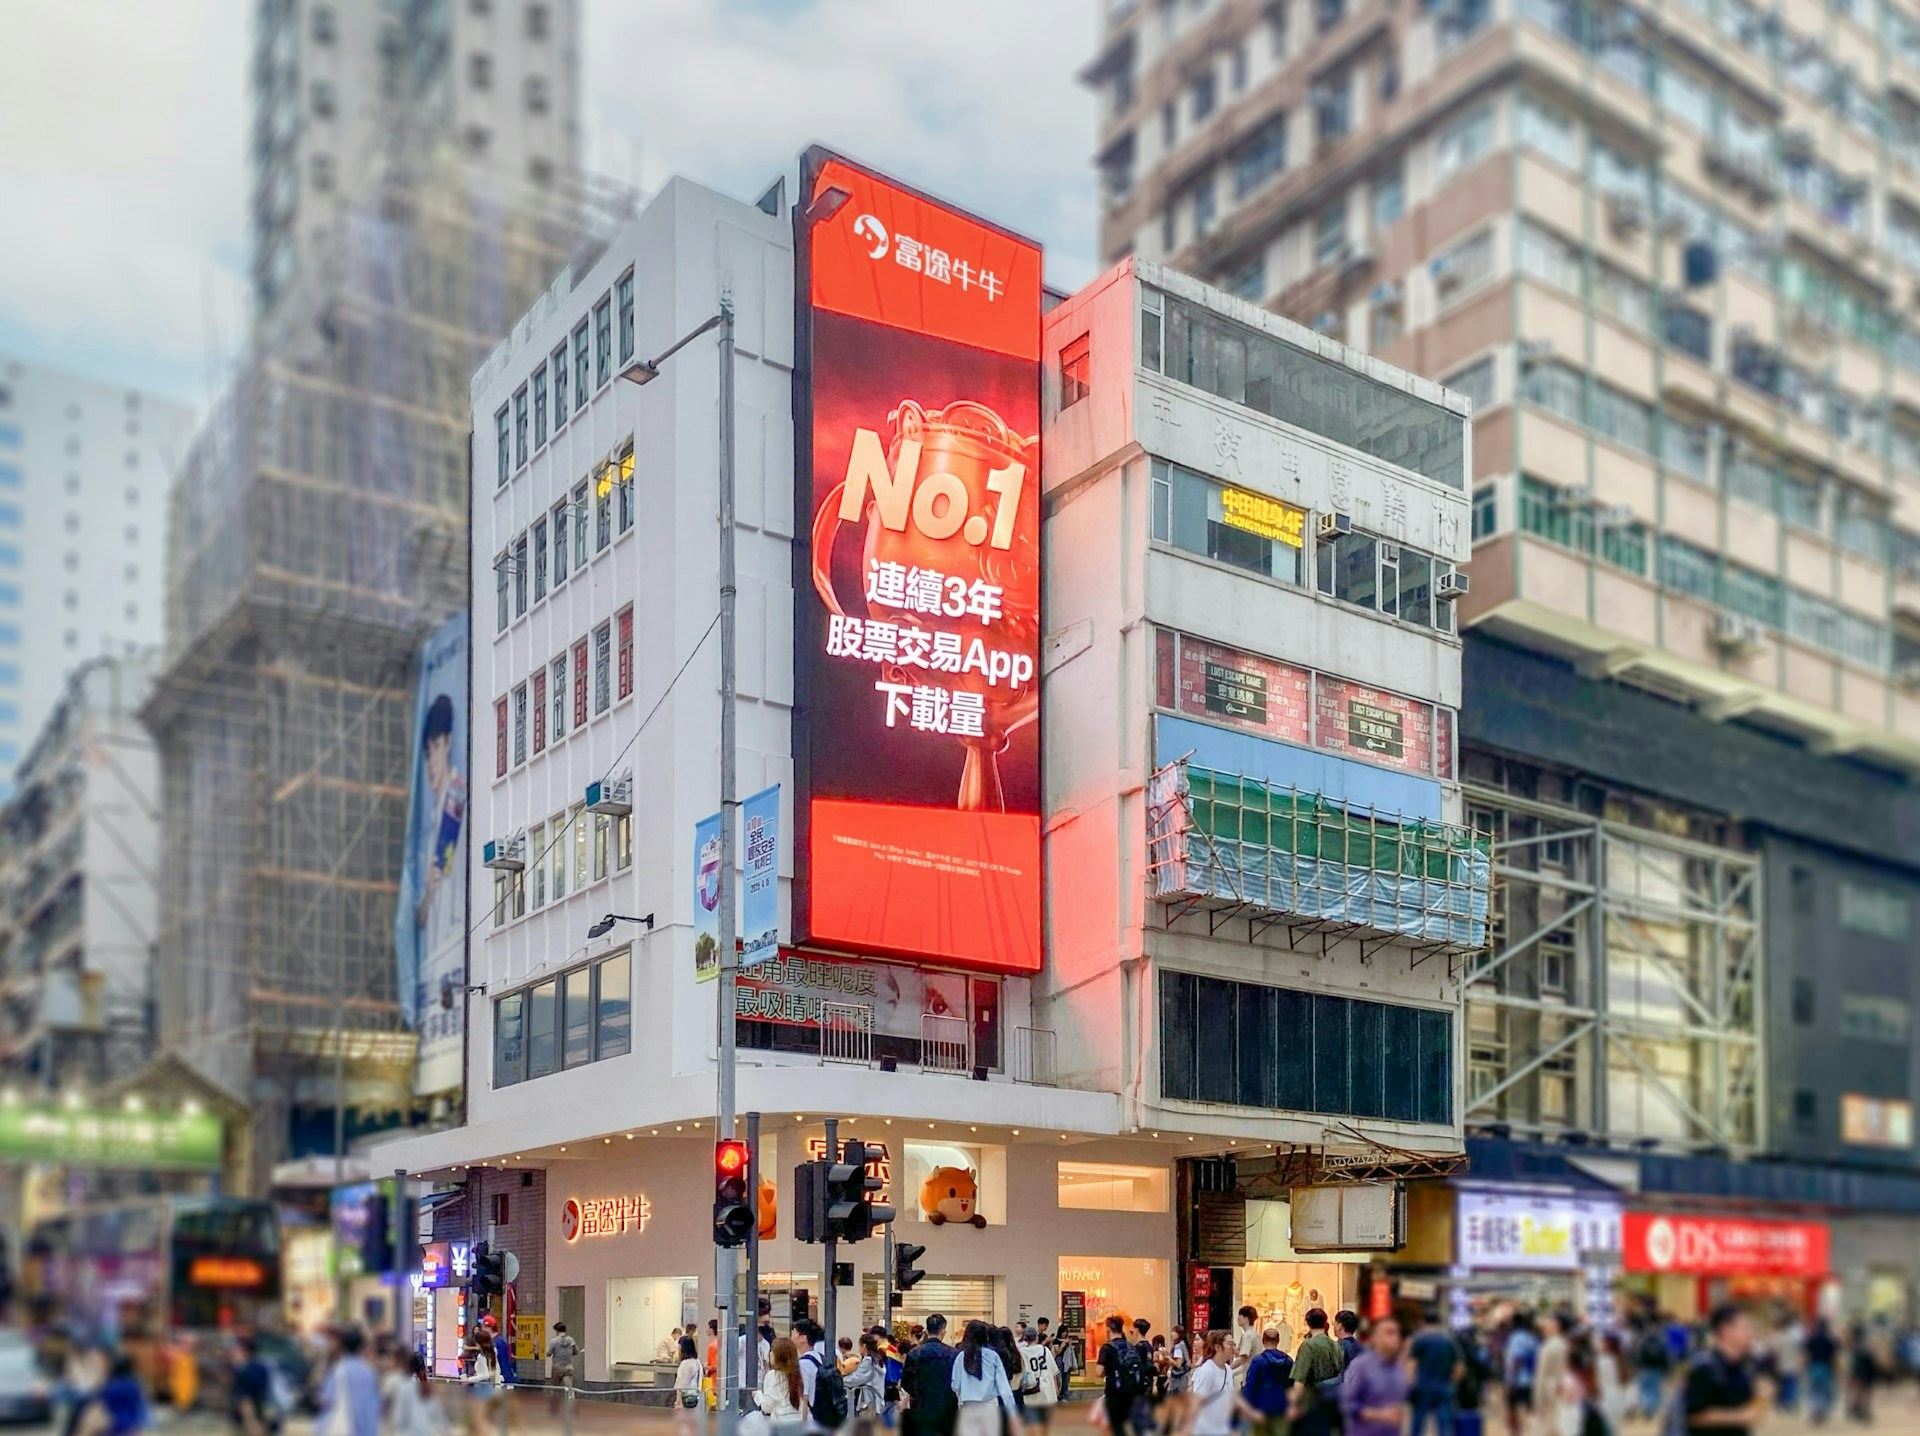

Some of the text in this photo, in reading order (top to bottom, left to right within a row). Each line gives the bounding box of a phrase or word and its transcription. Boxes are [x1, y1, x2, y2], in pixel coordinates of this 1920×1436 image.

[895, 233, 1004, 303] 富途牛牛
[838, 427, 1026, 551] No.1
[1272, 528, 1304, 549] FITNESS
[866, 558, 1003, 627] 連續3年
[826, 614, 1033, 689] 股票交易App
[1211, 666, 1224, 678] LOST
[1225, 669, 1246, 685] ESCAPE
[1246, 675, 1262, 688] GAME
[874, 681, 986, 738] 下載量
[1352, 703, 1366, 716] LOST
[1366, 706, 1385, 720] ESCAPE
[1385, 712, 1399, 724] GAME
[582, 1195, 651, 1235] 富途牛牛
[1073, 1270, 1102, 1281] FAMILY
[1029, 1355, 1047, 1372] 02
